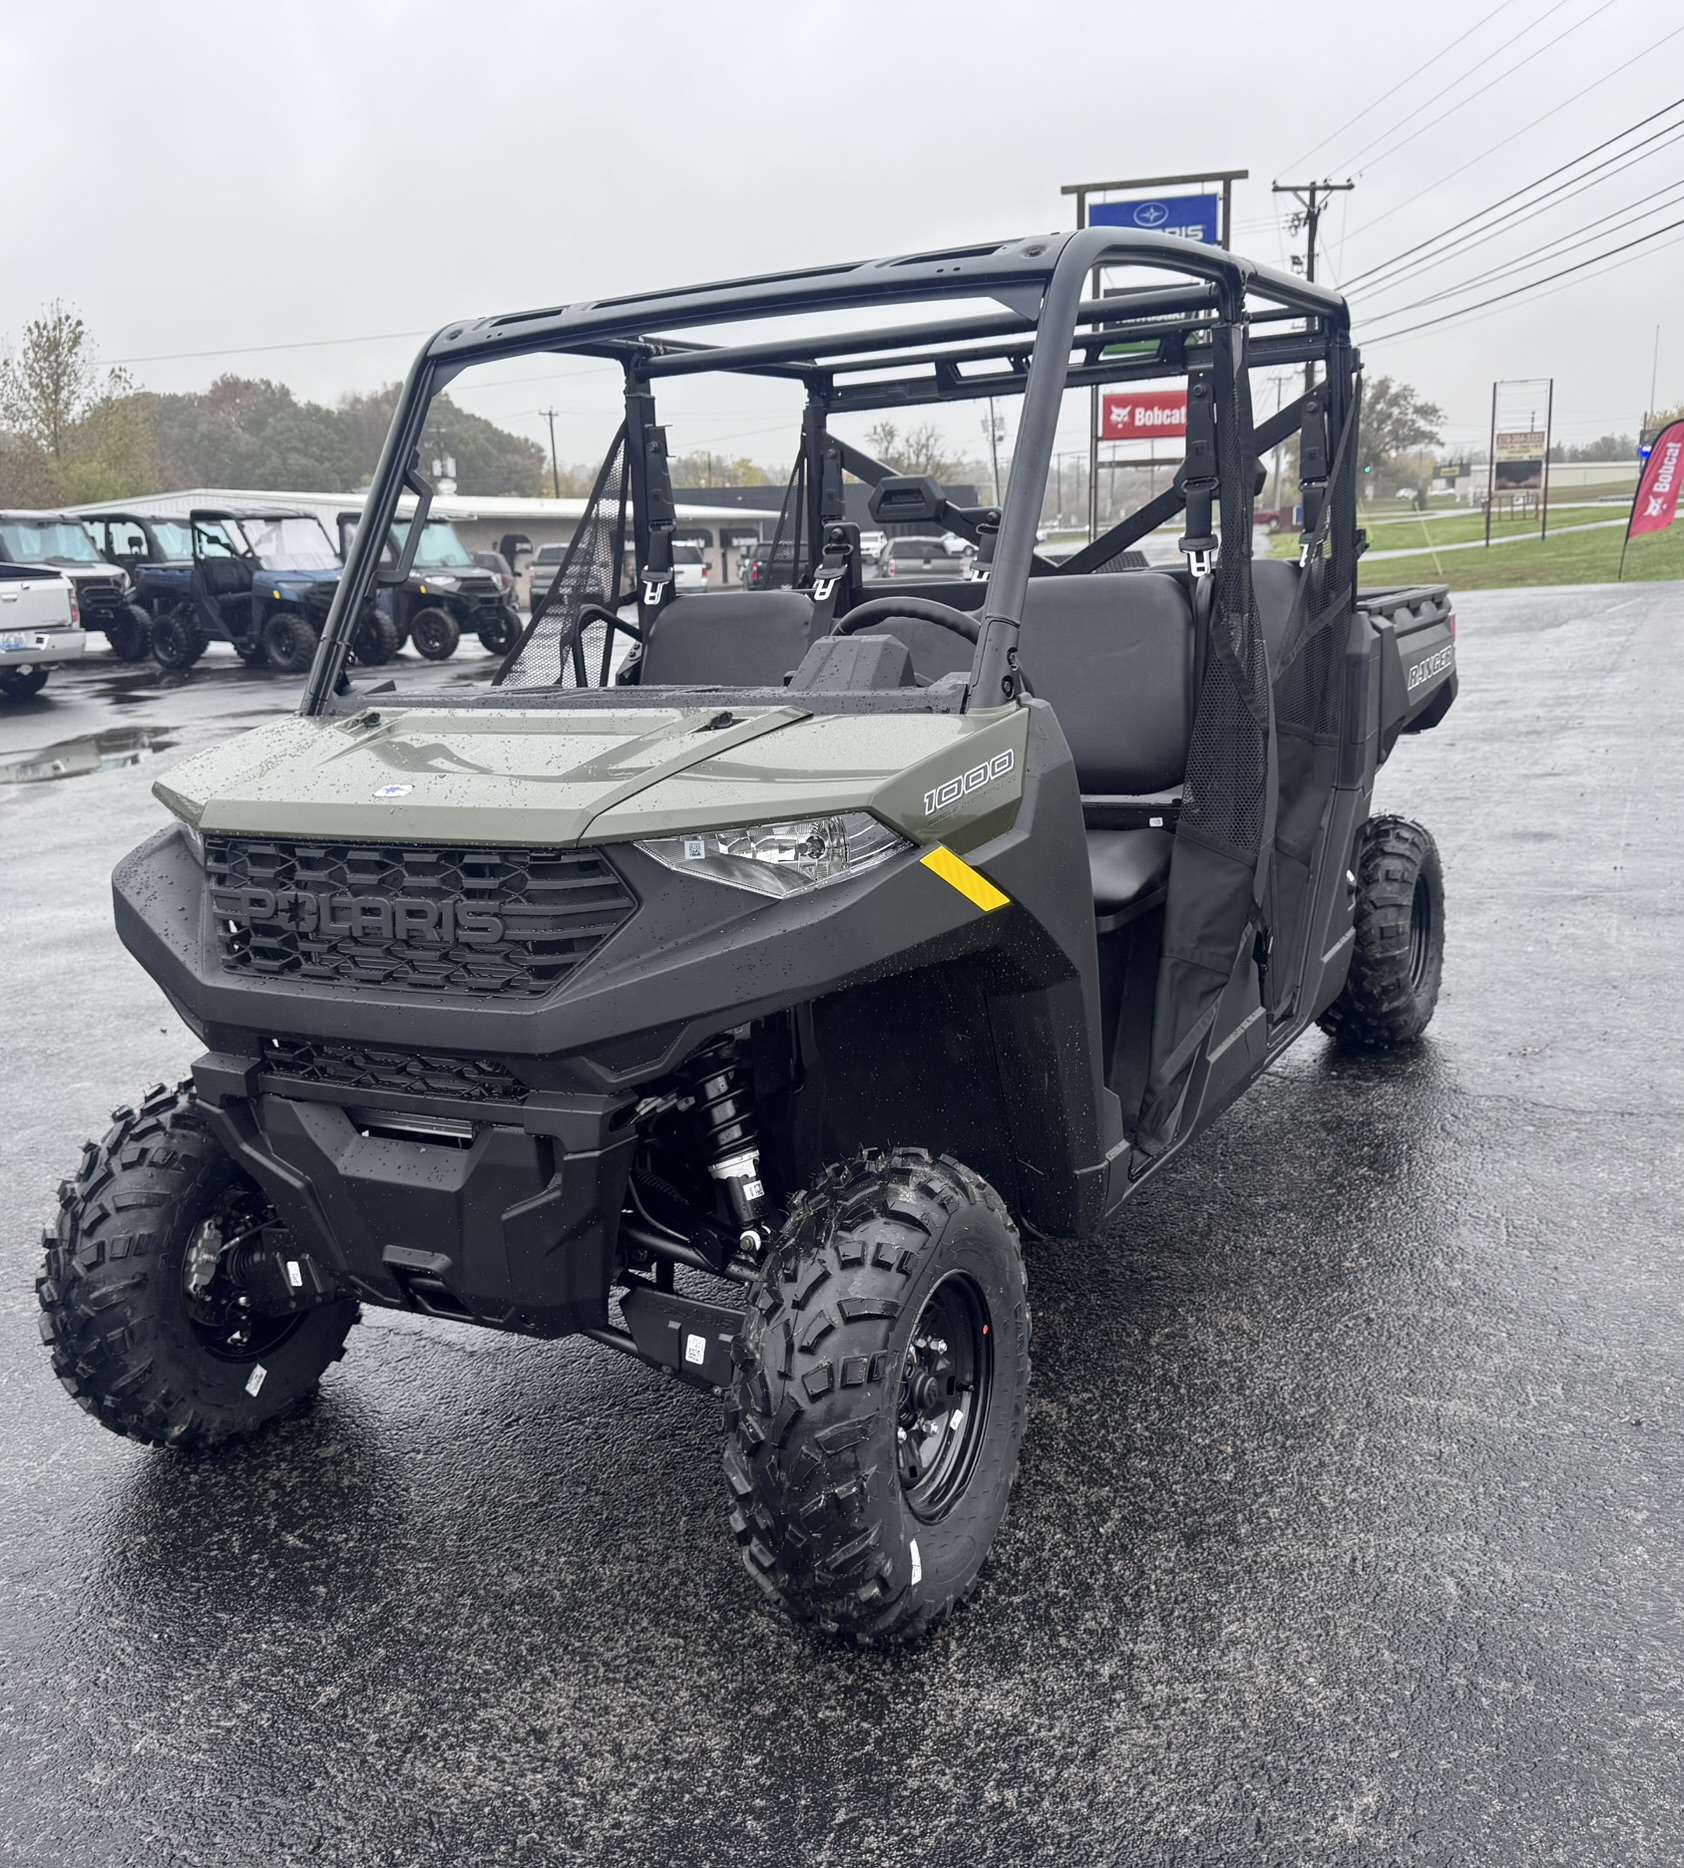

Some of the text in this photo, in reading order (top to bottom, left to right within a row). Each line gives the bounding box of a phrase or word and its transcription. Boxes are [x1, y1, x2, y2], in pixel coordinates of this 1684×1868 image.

[1134, 405, 1187, 427] Bobcat
[1652, 442, 1682, 493] Bobcat
[1407, 644, 1452, 692] RANGER
[923, 748, 1014, 816] 1000
[240, 886, 505, 944] POLARIS
